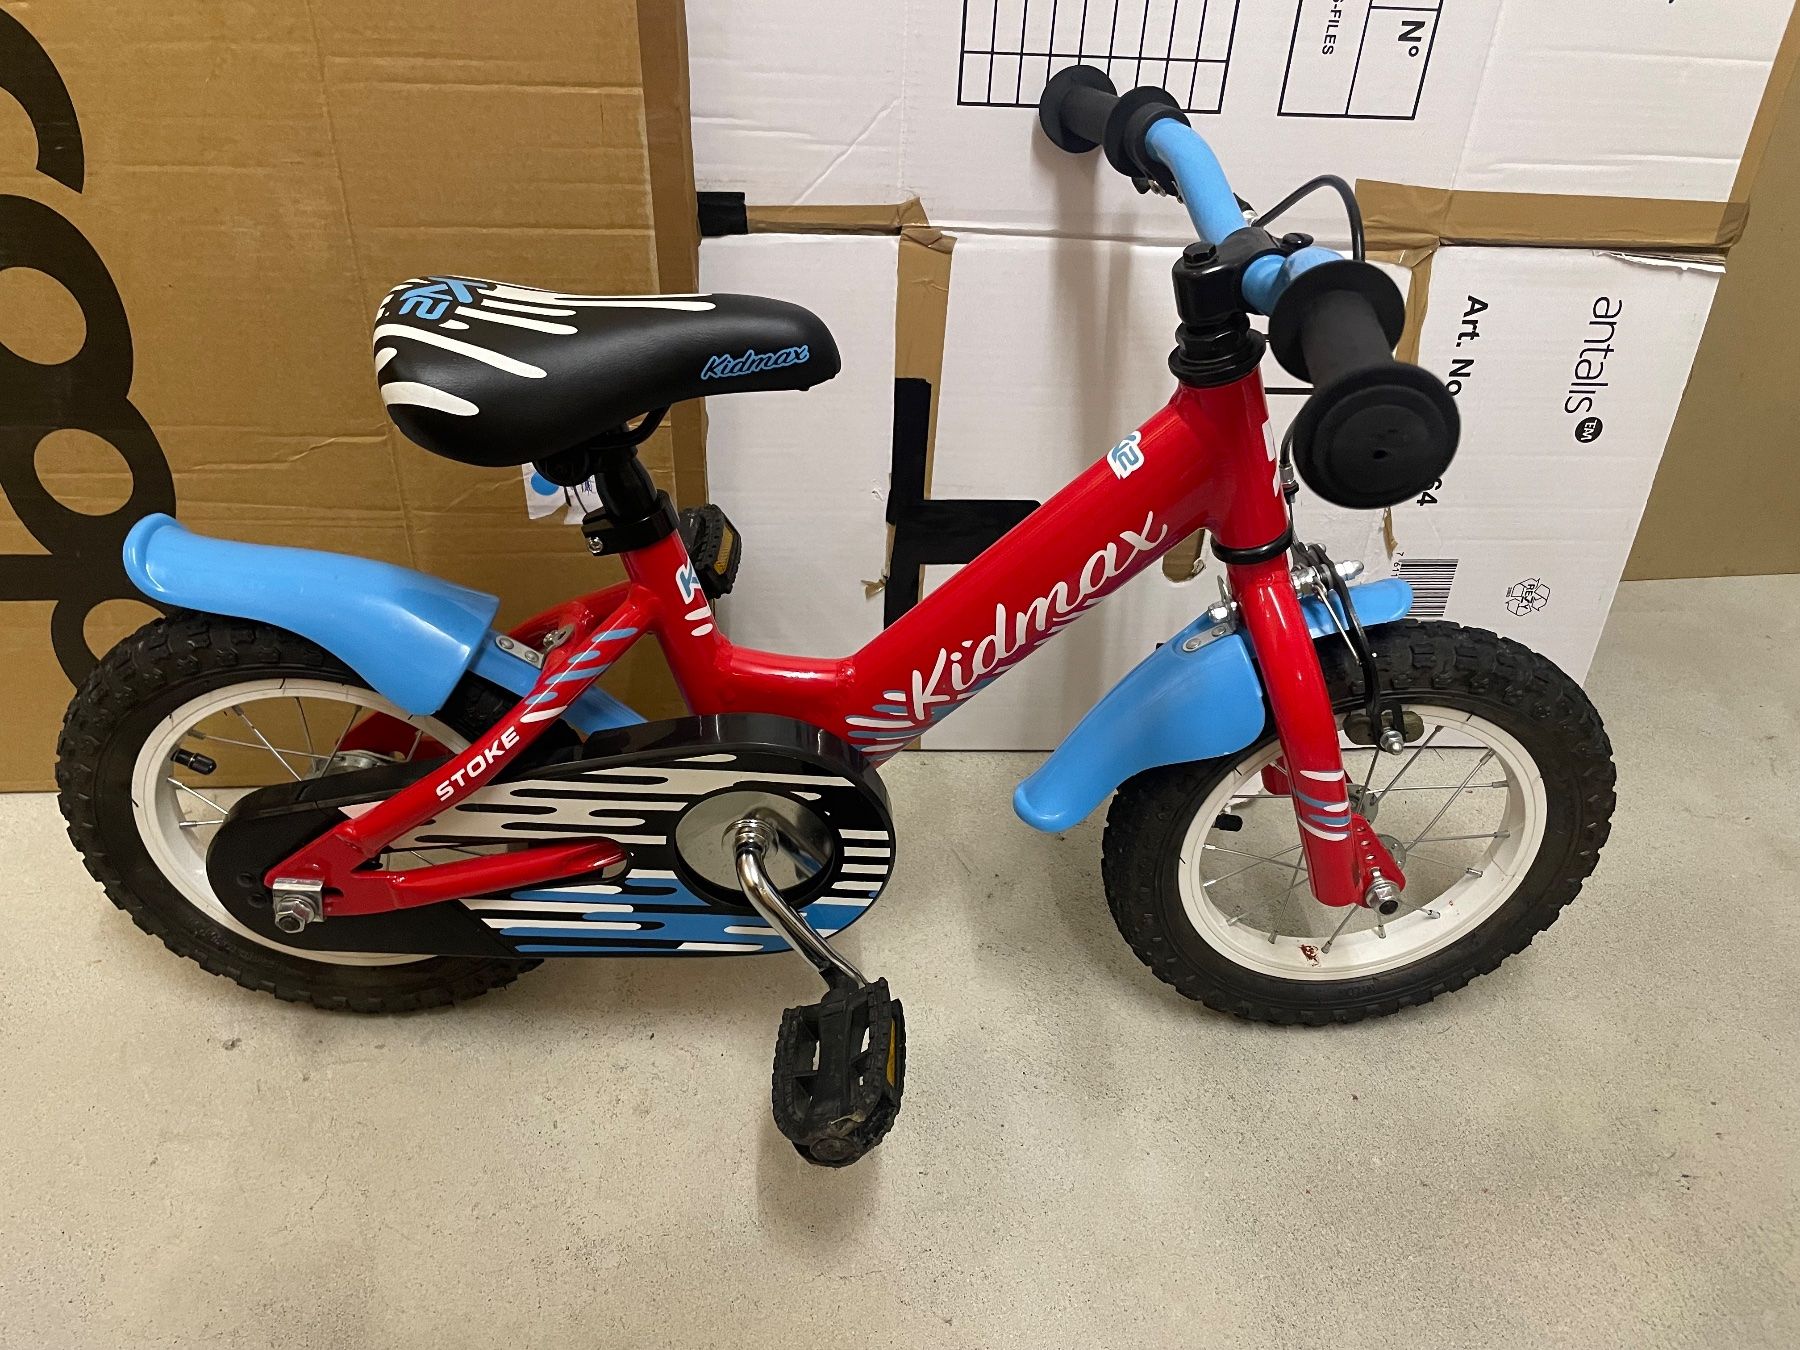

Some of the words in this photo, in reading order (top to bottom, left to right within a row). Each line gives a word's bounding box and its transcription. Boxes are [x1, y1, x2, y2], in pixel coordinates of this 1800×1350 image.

[1321, 0, 1342, 55] -FILES
[1456, 295, 1489, 348] Art.
[701, 345, 810, 380] Kidmax
[1564, 296, 1622, 414] antalis
[912, 511, 1168, 721] Kidmax
[436, 725, 520, 802] STOKE
